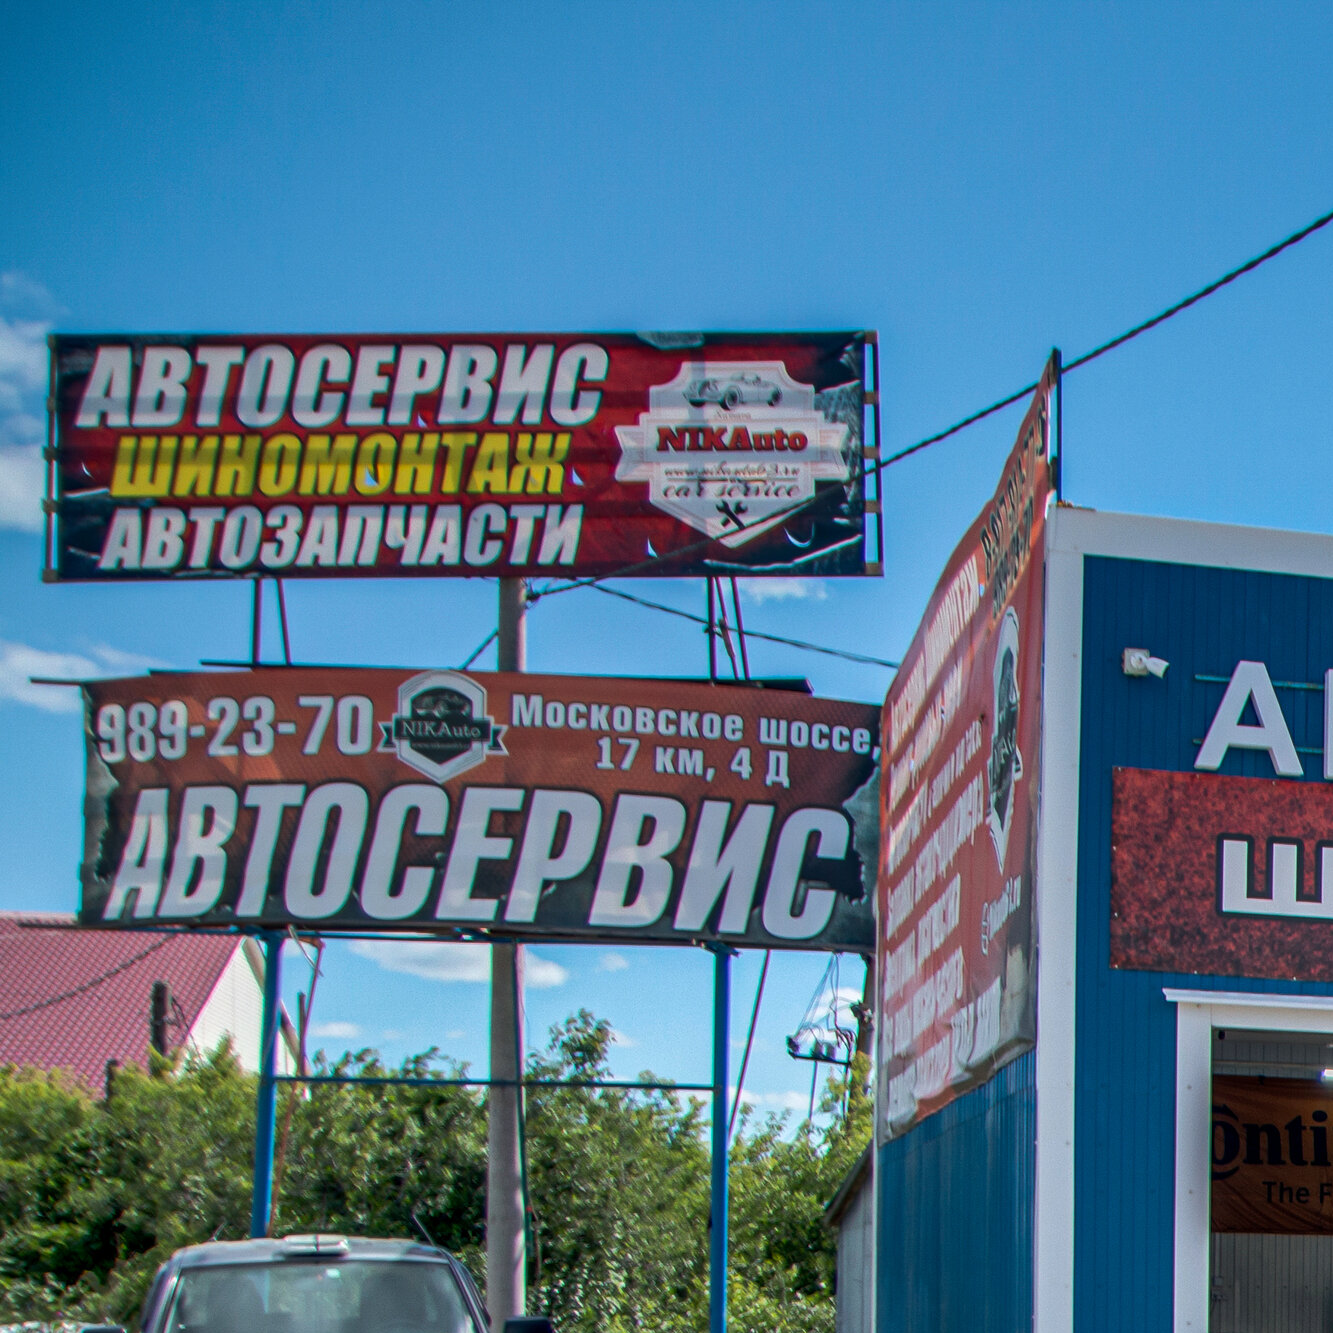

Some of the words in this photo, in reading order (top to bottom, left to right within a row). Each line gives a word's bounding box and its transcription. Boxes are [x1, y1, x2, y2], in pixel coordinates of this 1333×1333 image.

[75, 343, 610, 428] АВТОСЕРВИС
[110, 433, 571, 498] ШИНОМОНТАЖ
[656, 425, 808, 451] NIKAuto
[98, 504, 583, 570] АВТОЗАПЧАСТИ
[97, 696, 373, 763] 989-23-70
[402, 721, 481, 738] NIKAuto
[512, 694, 743, 741] Московское
[760, 719, 881, 758] шоссе,
[596, 738, 640, 770] 17
[655, 746, 715, 783] км,
[730, 748, 752, 780] 4
[766, 749, 790, 788] Д
[103, 783, 850, 940] АВТОСЕРВИС
[1262, 1181, 1309, 1204] The
